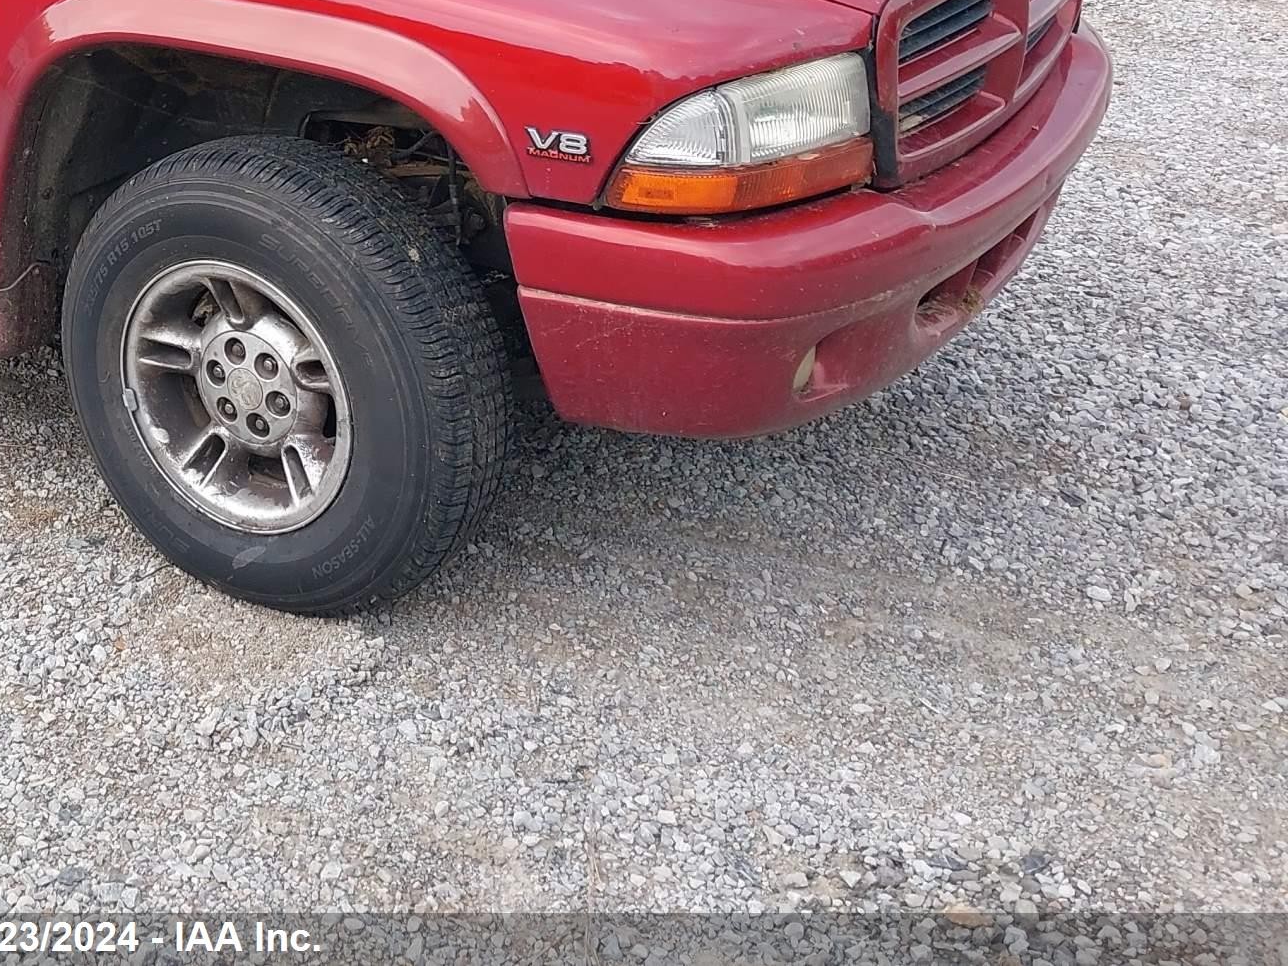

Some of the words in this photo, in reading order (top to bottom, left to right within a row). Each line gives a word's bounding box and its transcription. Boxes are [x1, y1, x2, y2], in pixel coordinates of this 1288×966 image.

[524, 125, 588, 155] V8
[527, 146, 591, 163] MAGNUM
[107, 237, 130, 266] R15
[130, 218, 162, 245] 105T
[312, 514, 375, 579] ALL-SEASON
